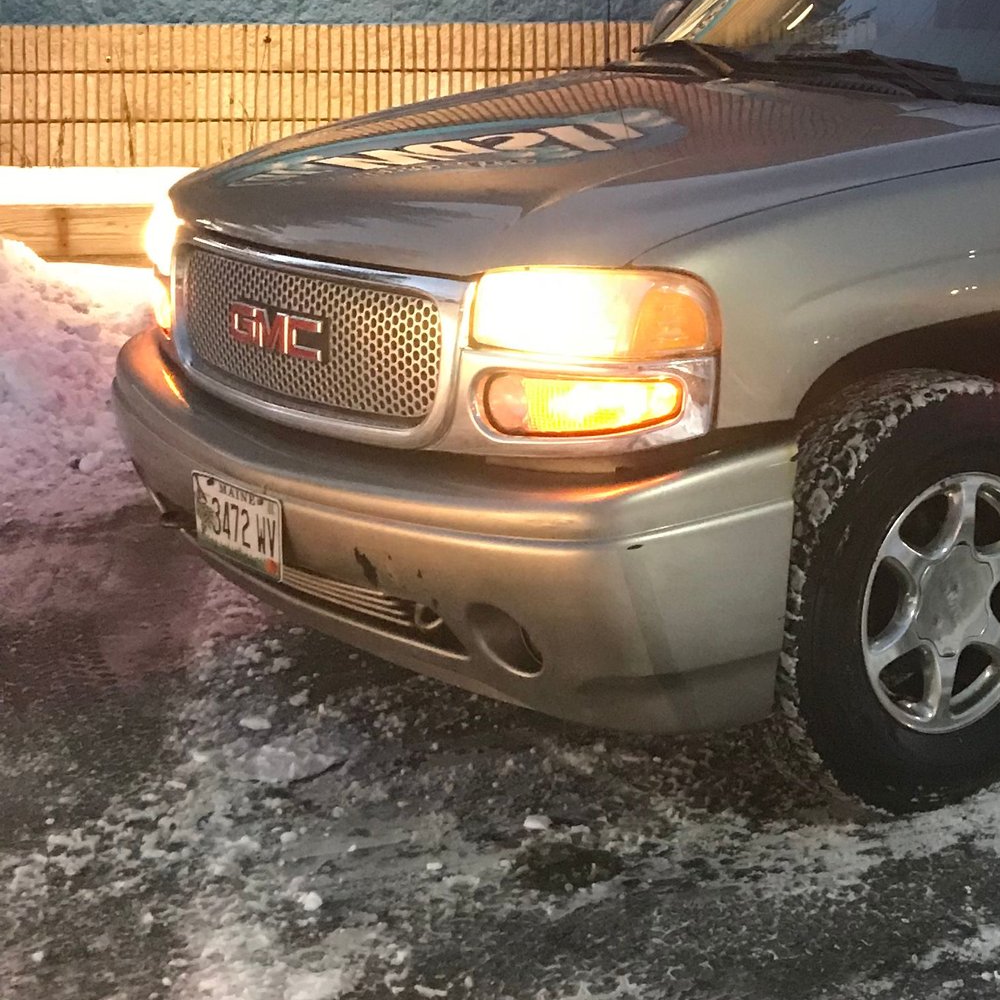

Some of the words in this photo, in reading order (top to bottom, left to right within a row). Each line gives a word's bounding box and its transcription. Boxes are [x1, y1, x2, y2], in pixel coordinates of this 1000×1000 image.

[229, 301, 322, 361] GMC
[219, 483, 256, 505] MAINE
[212, 497, 251, 549] 3472
